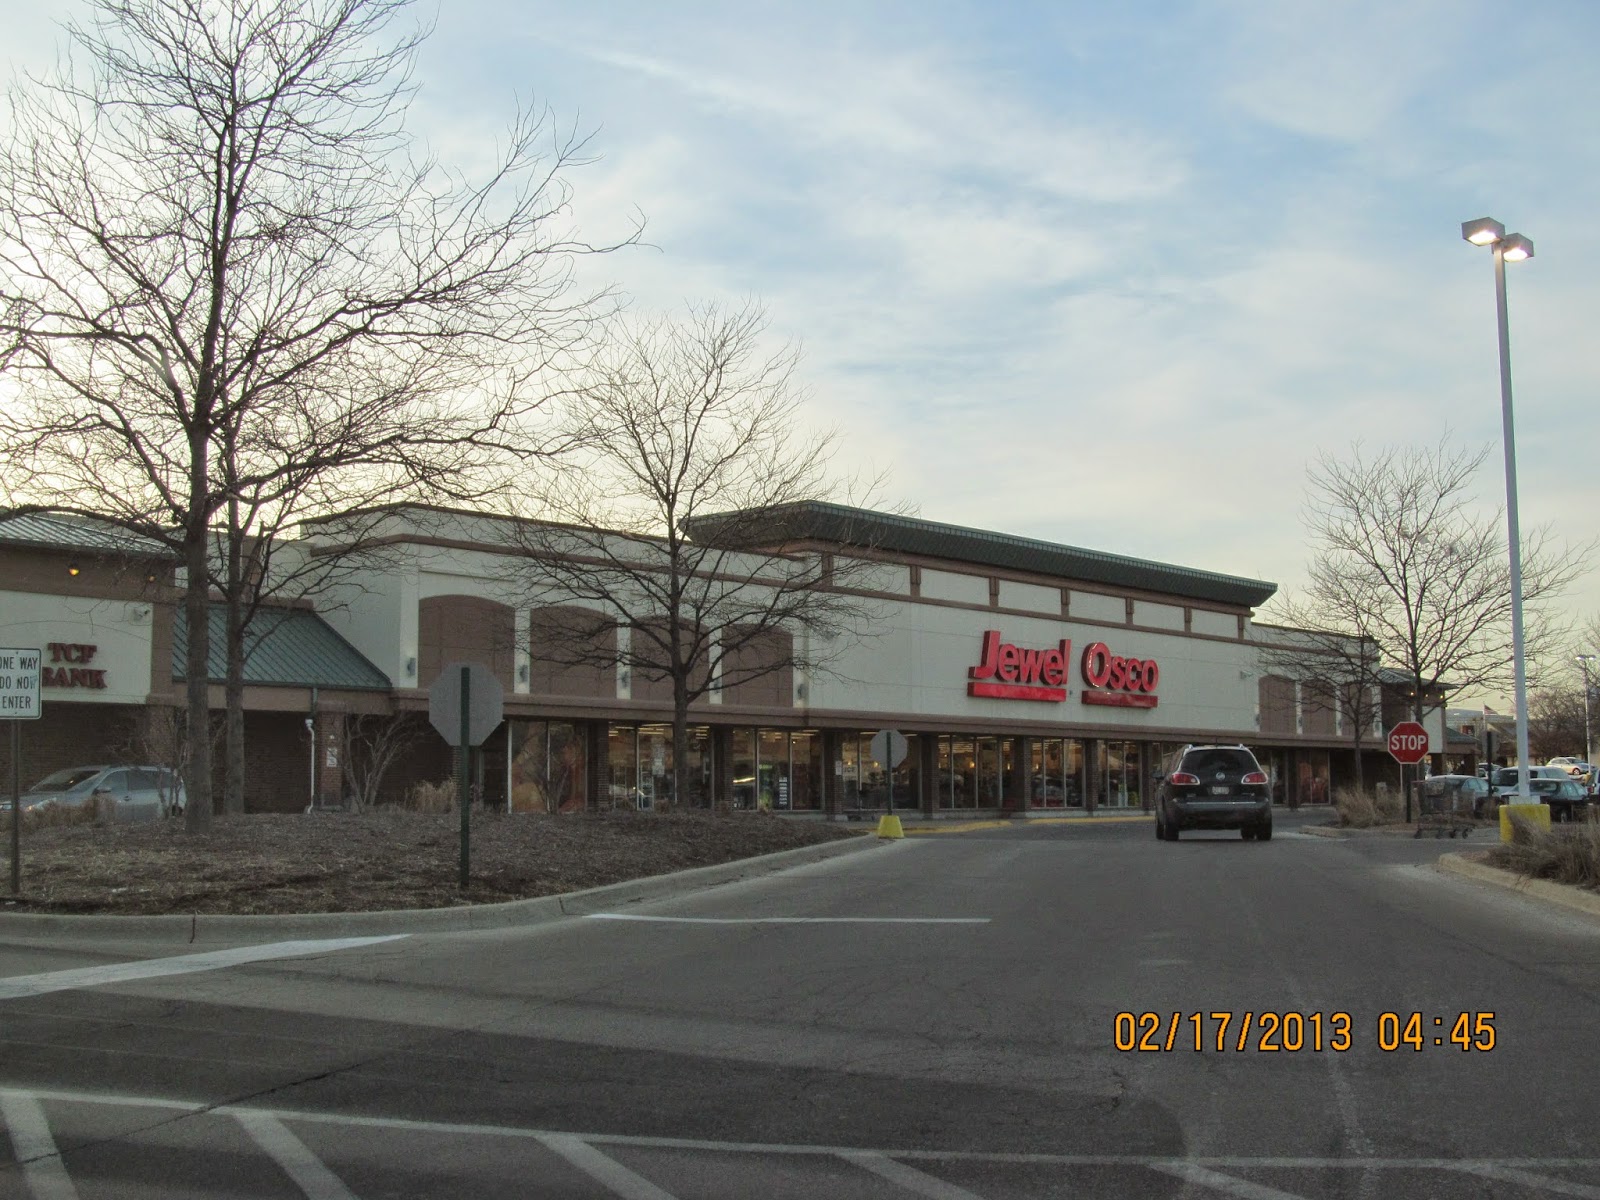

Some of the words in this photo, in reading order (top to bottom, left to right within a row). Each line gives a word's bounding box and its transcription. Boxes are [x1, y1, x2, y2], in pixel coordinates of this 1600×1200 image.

[47, 643, 97, 664] TCF
[968, 630, 1071, 686] Jewel
[1081, 642, 1159, 692] Osco
[20, 657, 38, 670] WAY
[0, 676, 11, 689] DO
[42, 667, 108, 690] BANK
[3, 696, 31, 709] ENTER
[1391, 735, 1427, 750] STOP
